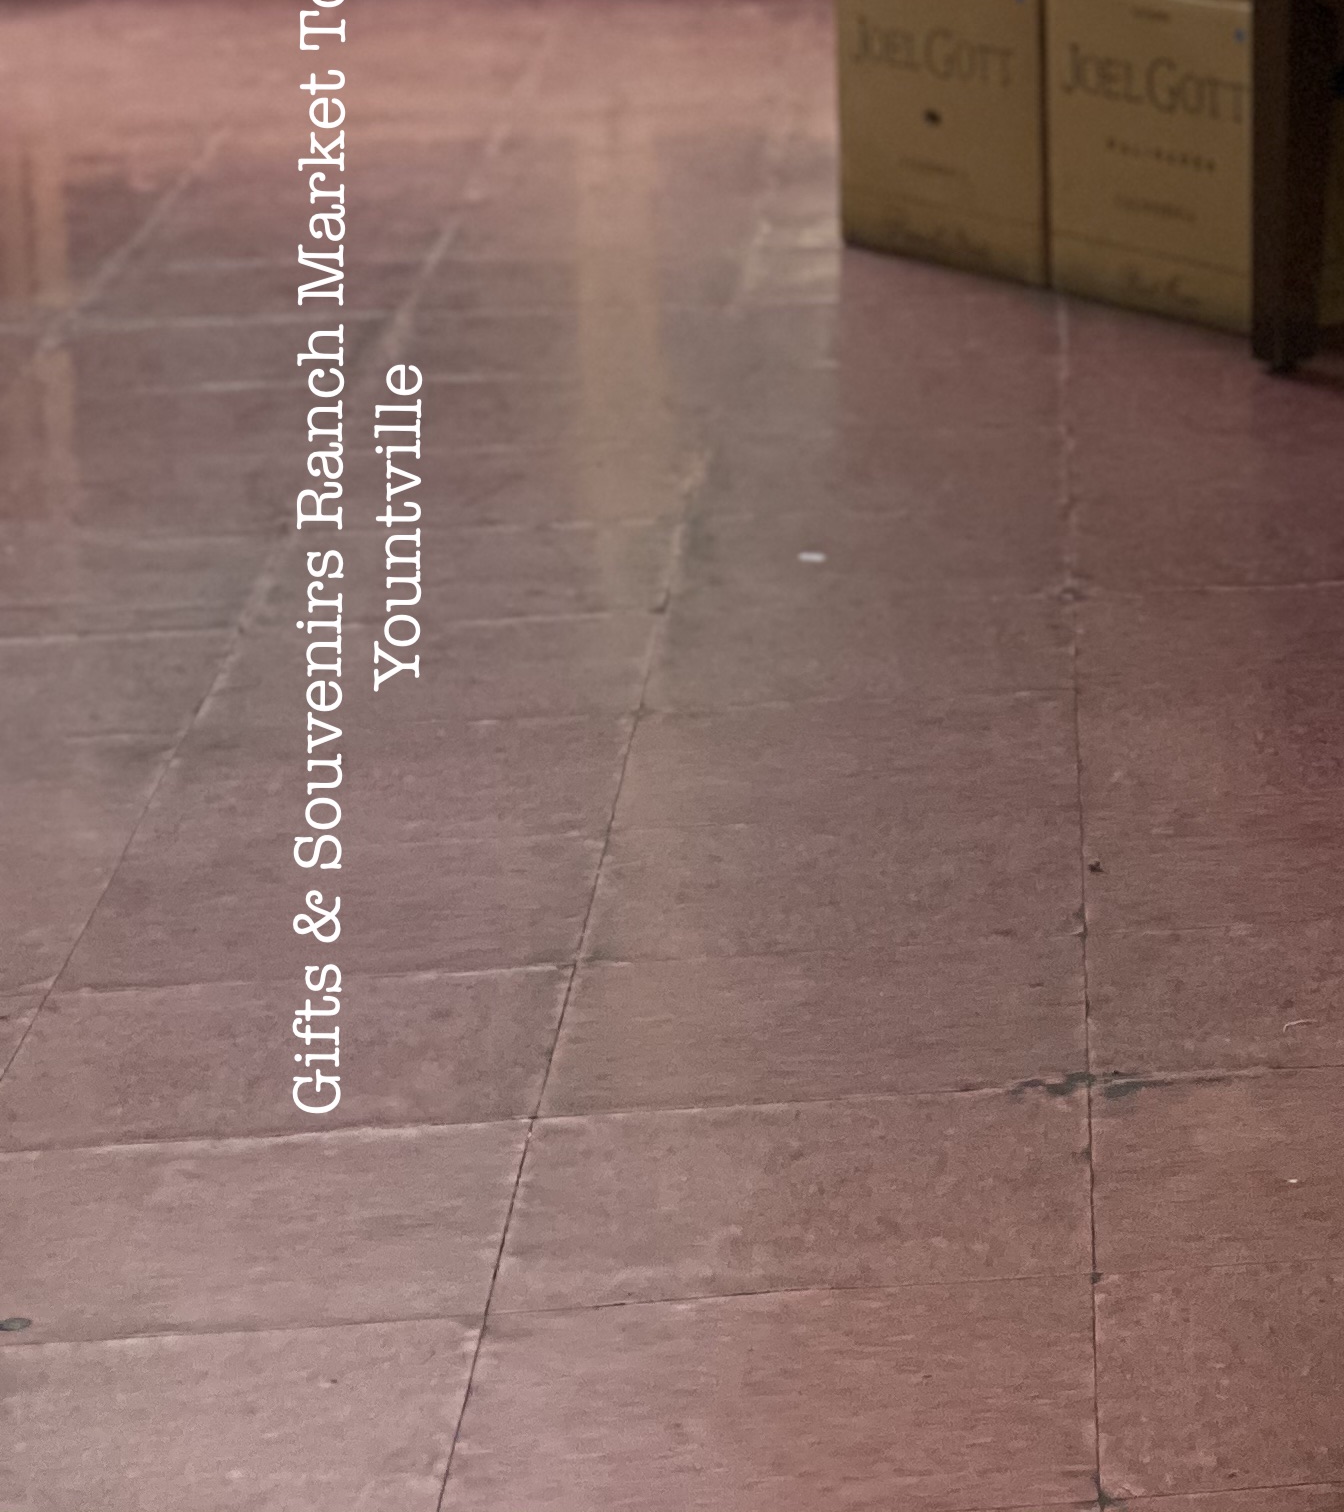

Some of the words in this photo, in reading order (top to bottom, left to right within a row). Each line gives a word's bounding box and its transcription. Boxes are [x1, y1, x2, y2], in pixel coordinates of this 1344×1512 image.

[923, 28, 1015, 90] GOTT
[1062, 42, 1145, 107] JOEL
[1146, 55, 1245, 126] GOTT
